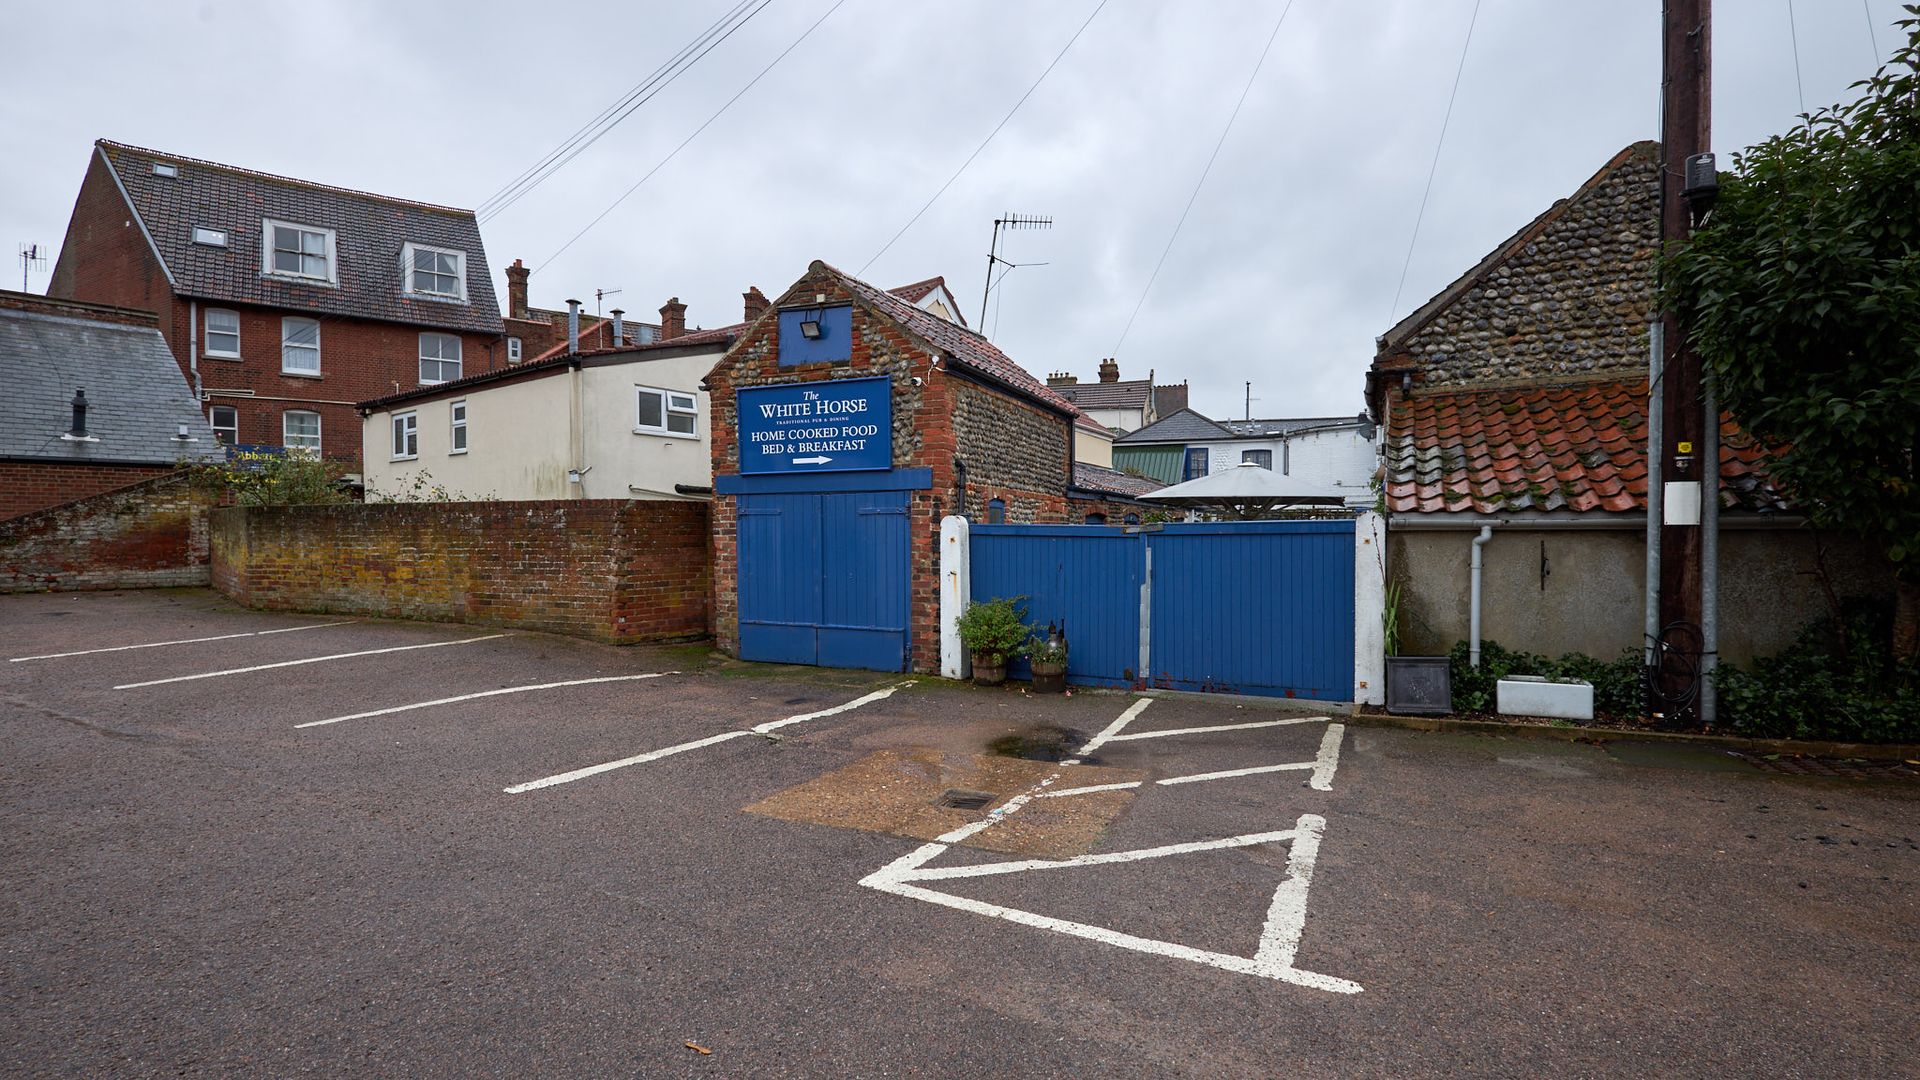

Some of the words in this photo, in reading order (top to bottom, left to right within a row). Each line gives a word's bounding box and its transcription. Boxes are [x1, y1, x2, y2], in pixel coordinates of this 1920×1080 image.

[803, 391, 819, 400] The
[759, 403, 811, 418] WHITE
[816, 399, 867, 414] HORSE
[751, 430, 785, 442] HOME
[788, 427, 838, 440] COOKED
[842, 425, 877, 437] FOOD
[762, 443, 784, 455] BED
[787, 443, 795, 453] &
[798, 439, 866, 453] BREAKFAST
